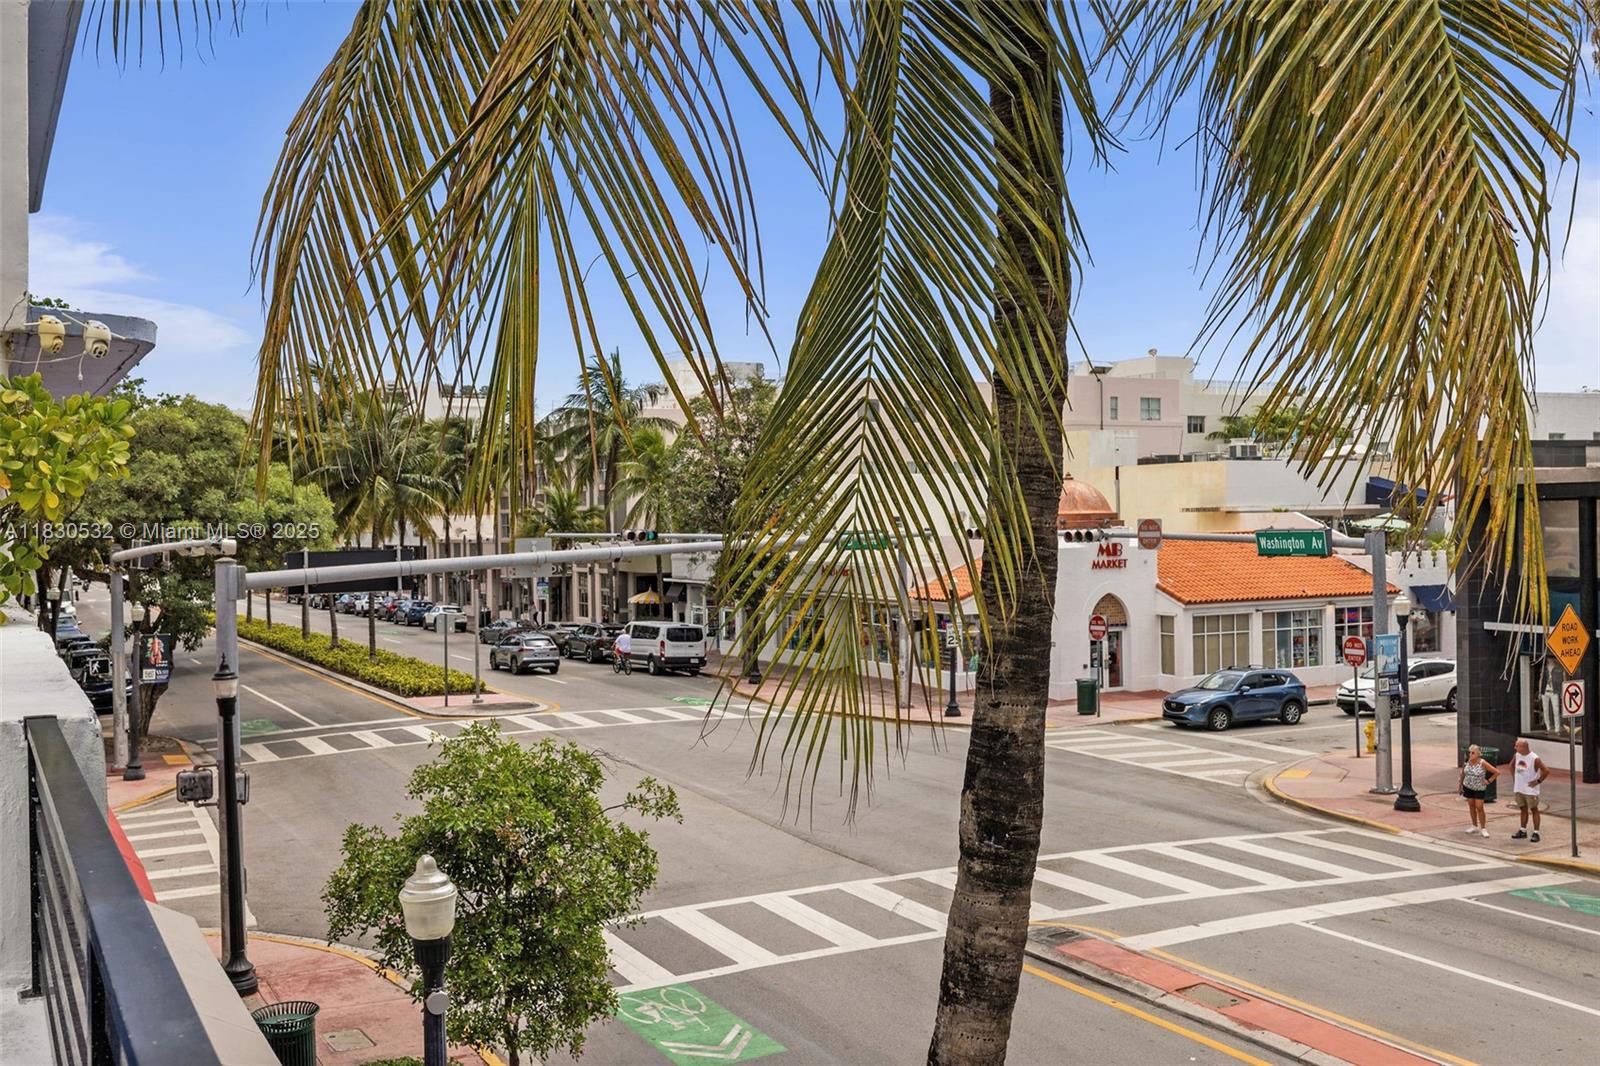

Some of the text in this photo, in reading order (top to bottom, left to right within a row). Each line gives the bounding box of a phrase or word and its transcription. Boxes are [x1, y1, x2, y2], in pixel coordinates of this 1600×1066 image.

[1259, 536, 1323, 553] Washington Av
[1092, 559, 1128, 569] MARKET
[1562, 622, 1578, 632] ROAD
[1562, 635, 1579, 645] WORK
[1560, 647, 1581, 658] AHEAD
